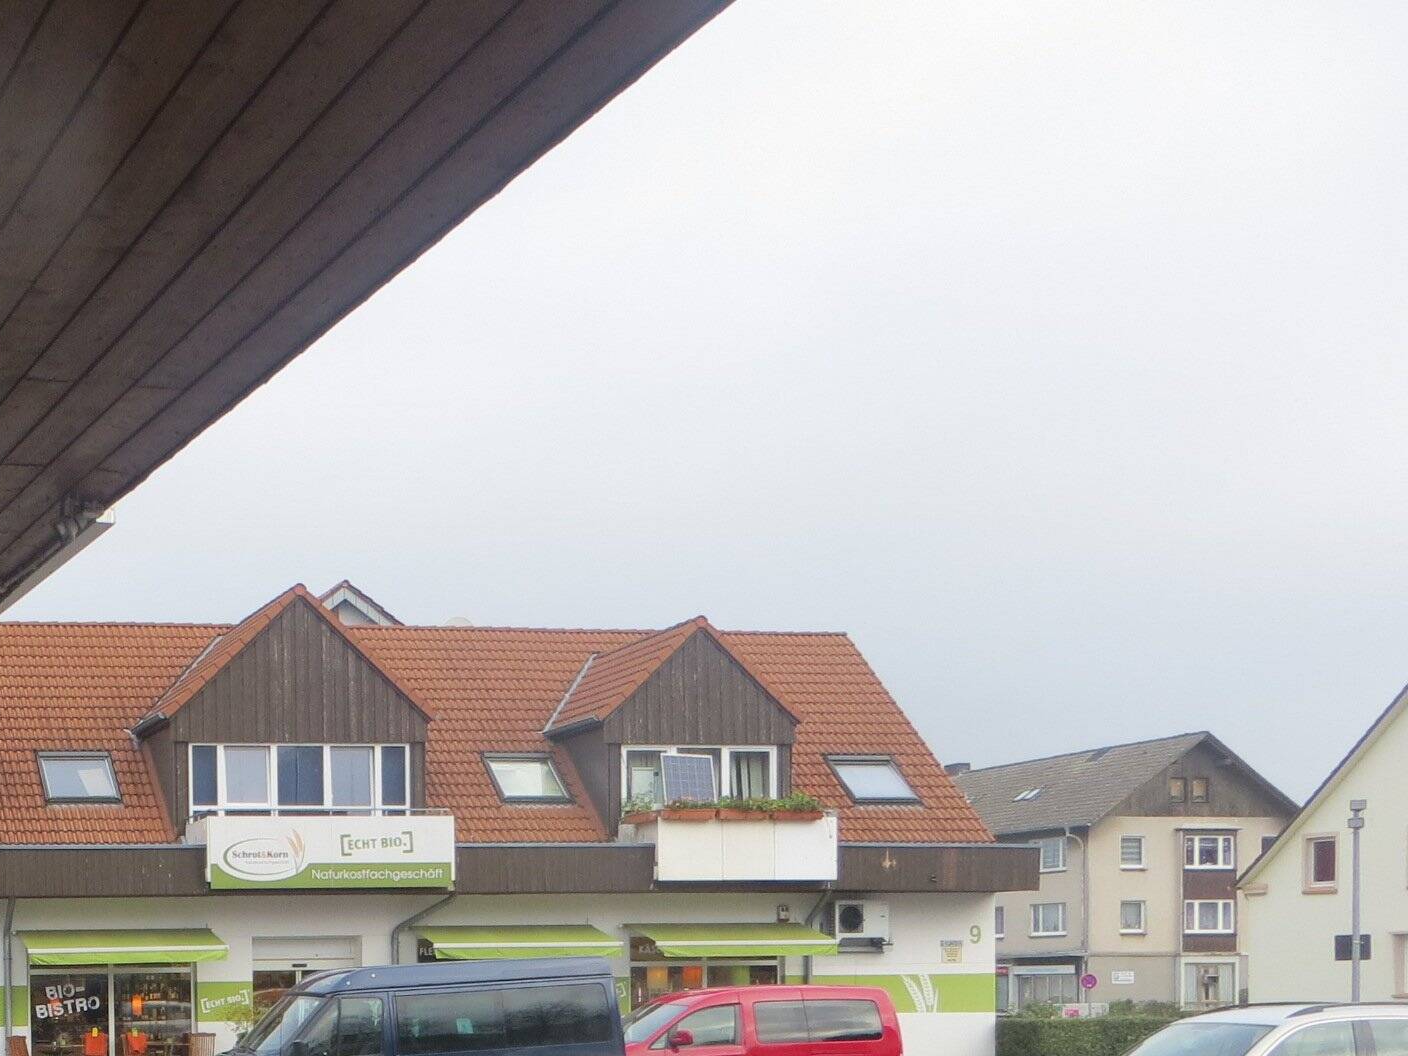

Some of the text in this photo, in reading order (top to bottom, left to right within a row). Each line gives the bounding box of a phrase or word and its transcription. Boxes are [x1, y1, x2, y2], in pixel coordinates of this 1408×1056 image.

[311, 868, 443, 882] Naturkostfachgeschäft
[969, 924, 982, 945] 9
[45, 985, 86, 1001] BIO-
[35, 995, 101, 1020] BISTRO
